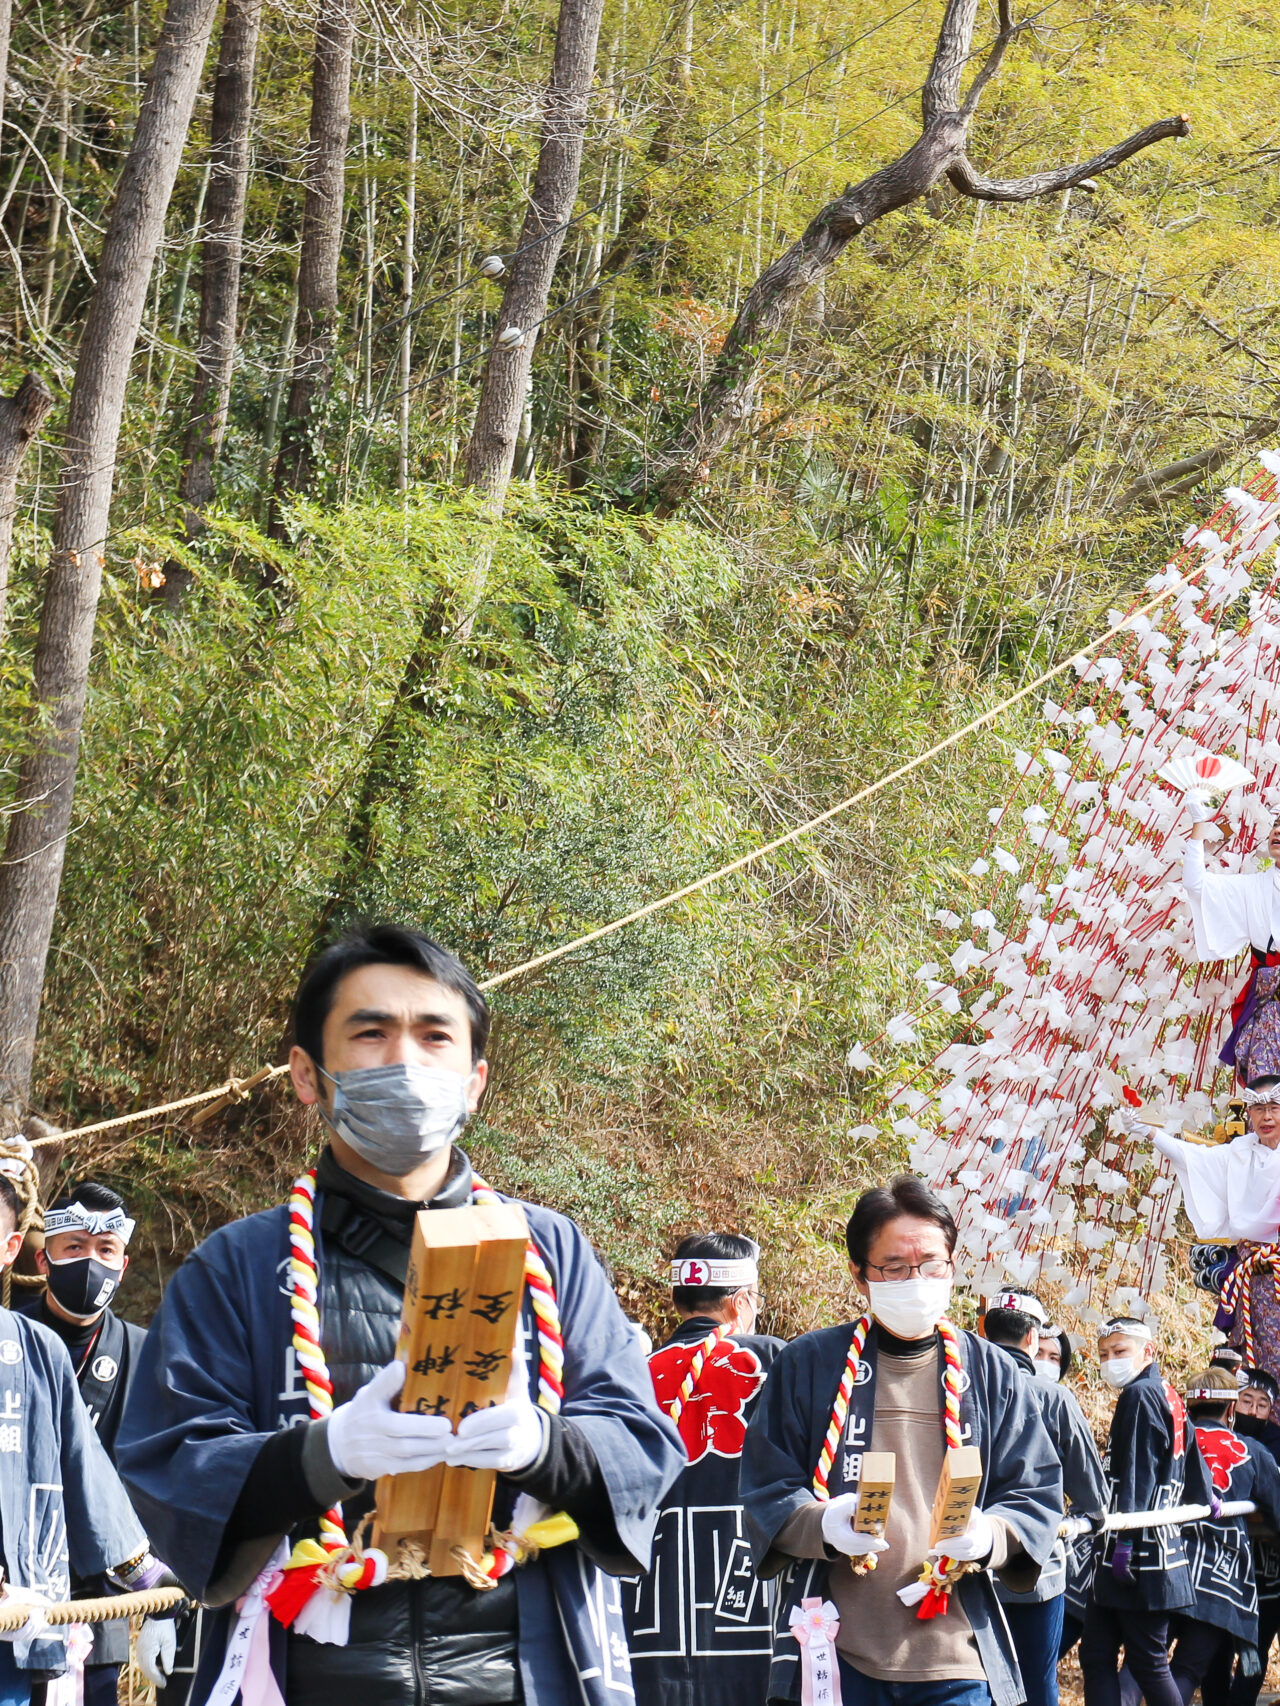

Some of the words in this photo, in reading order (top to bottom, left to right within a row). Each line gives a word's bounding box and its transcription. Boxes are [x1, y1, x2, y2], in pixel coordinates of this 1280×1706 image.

[684, 1261, 702, 1285] 上
[1003, 1294, 1017, 1310] 上
[0, 1389, 22, 1453] 上組
[842, 1414, 867, 1482] 上組
[725, 1555, 753, 1609] 上組
